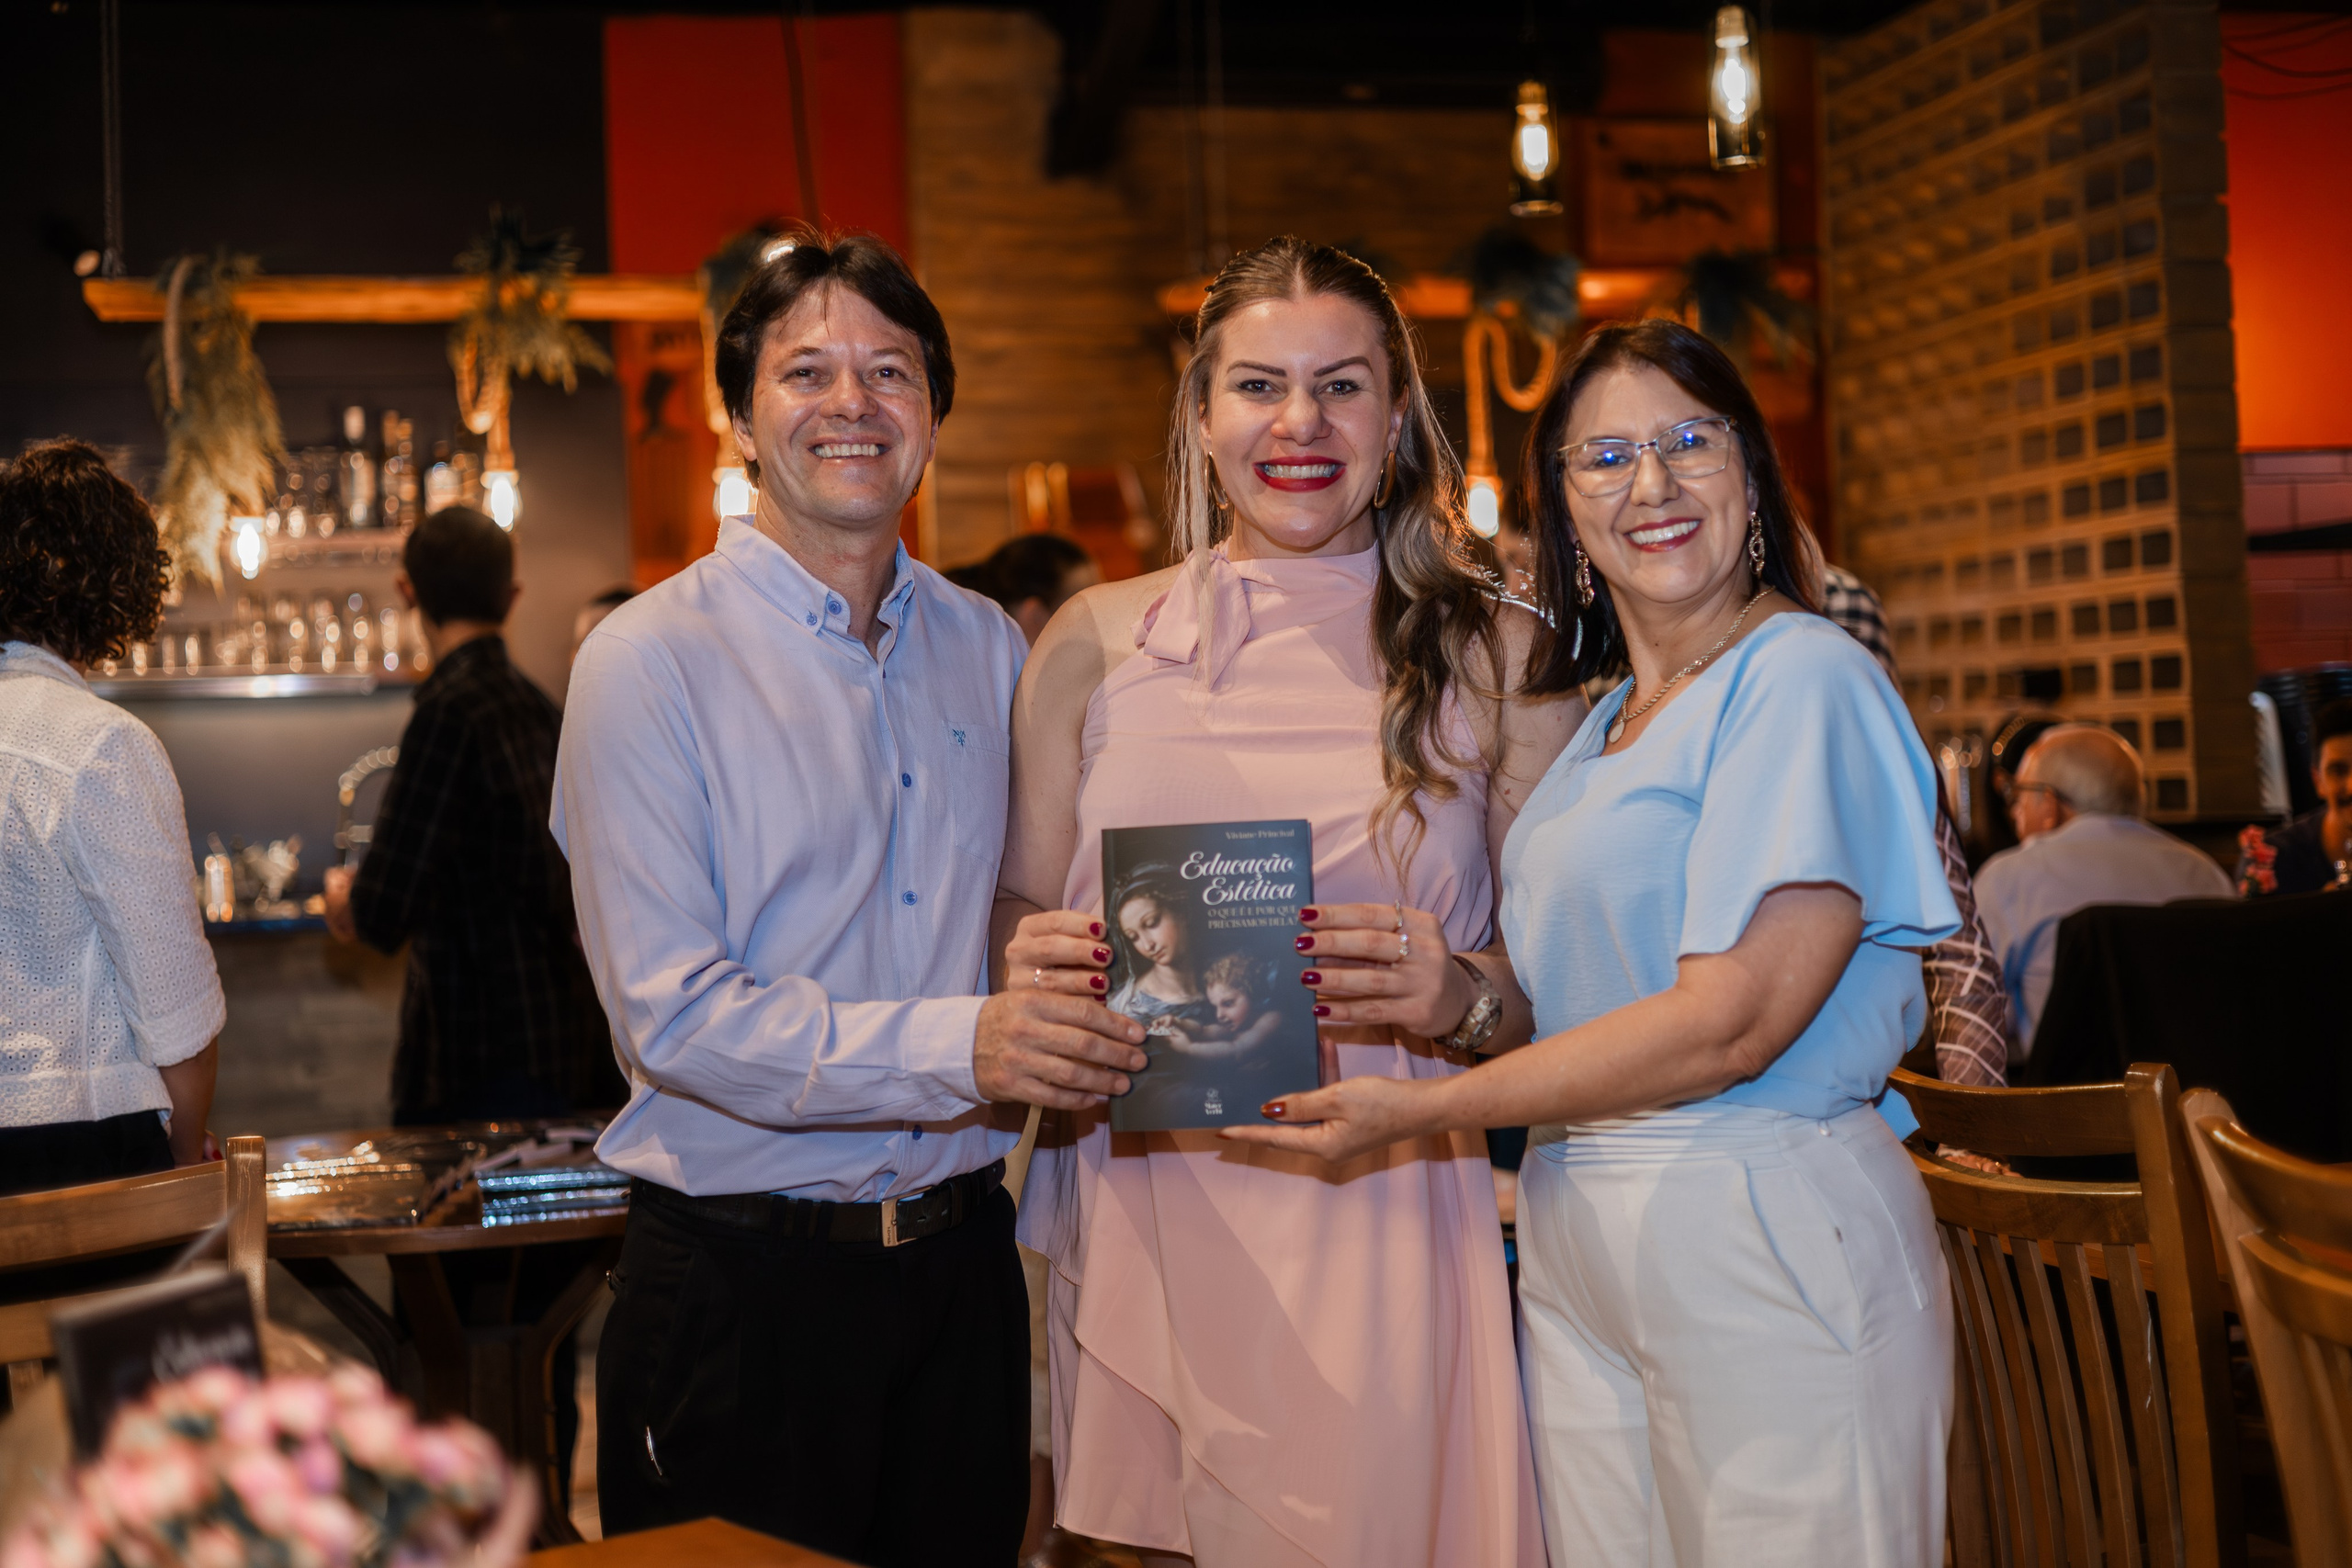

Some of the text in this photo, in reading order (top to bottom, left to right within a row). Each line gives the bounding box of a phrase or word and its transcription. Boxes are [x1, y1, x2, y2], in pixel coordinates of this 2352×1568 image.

[1180, 851, 1295, 880] Educação
[1203, 876, 1297, 906] Estética
[1207, 908, 1216, 918] O
[1217, 907, 1238, 919] QUE
[1255, 905, 1275, 916] POR
[1277, 905, 1296, 917] QUE
[1208, 919, 1268, 930] PRECISAMOS
